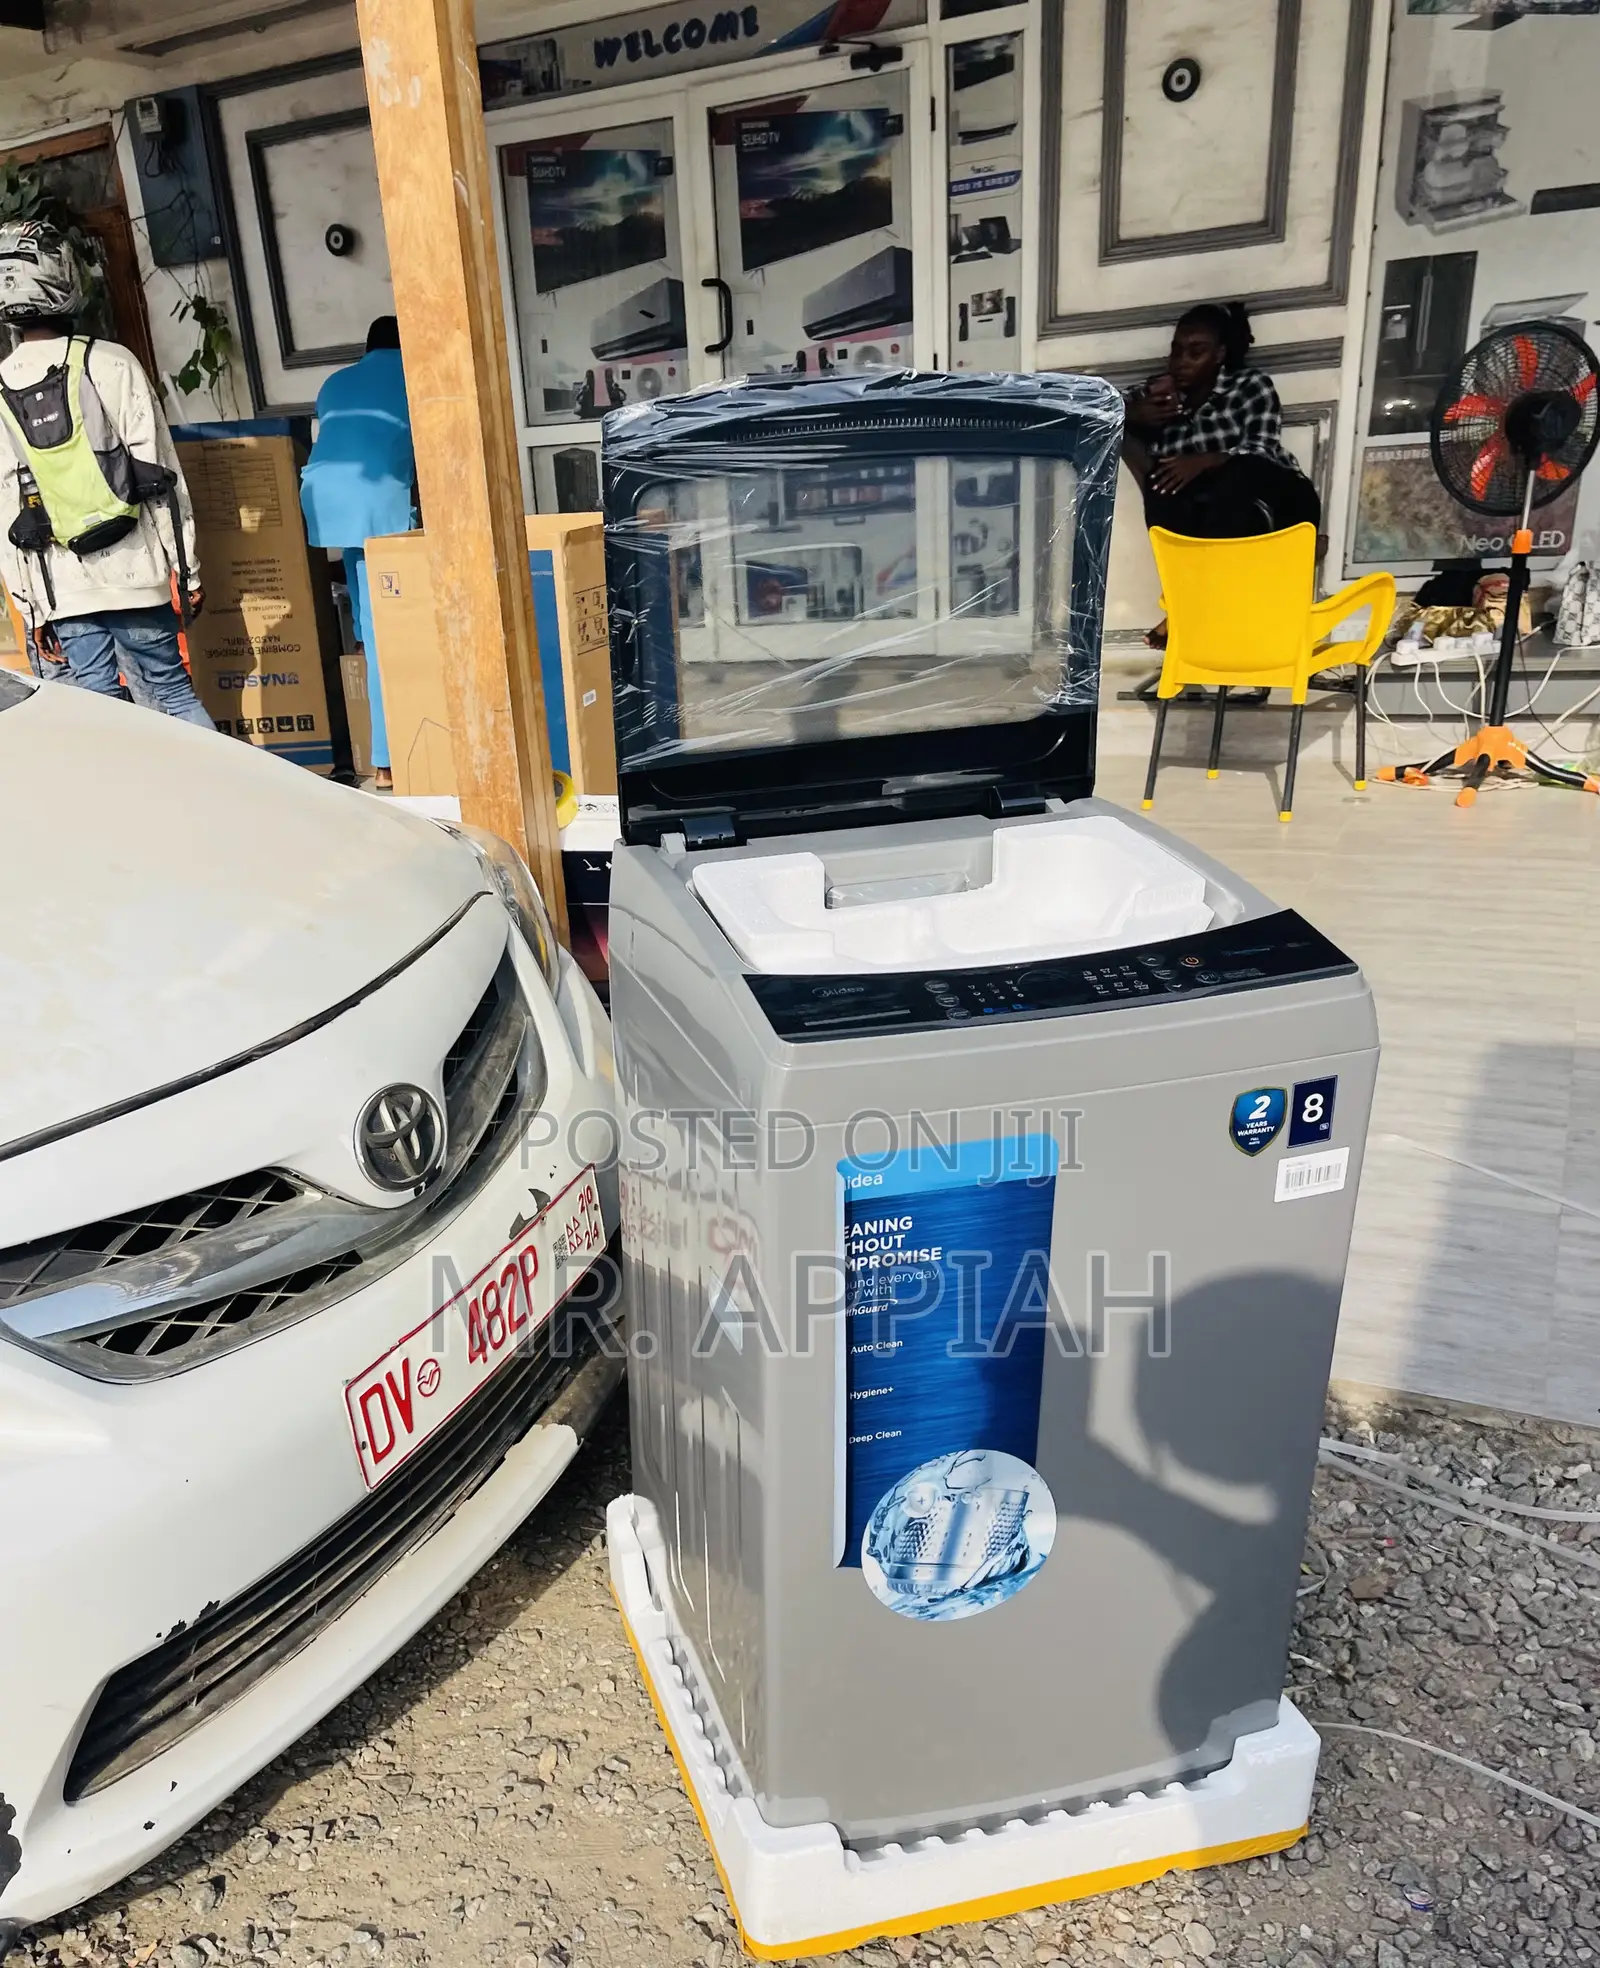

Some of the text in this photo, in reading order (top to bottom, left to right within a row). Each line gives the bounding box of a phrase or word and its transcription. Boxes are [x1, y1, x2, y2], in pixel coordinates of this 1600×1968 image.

[594, 5, 759, 68] WELCOME
[1460, 530, 1566, 552] Neo LED
[246, 643, 301, 657] COMBINED
[218, 672, 286, 690] NASCO
[1248, 1095, 1272, 1120] 2
[1302, 1093, 1324, 1123] 8
[1237, 1125, 1276, 1137] WARRANTY
[1246, 1120, 1268, 1129] YEARS
[845, 1172, 885, 1190] idea
[878, 1268, 940, 1285] everyday
[863, 1283, 893, 1297] with
[359, 1244, 539, 1466] DV 482P
[850, 1340, 904, 1355] Auto Clean
[849, 1386, 894, 1401] Hygiene+
[848, 1429, 902, 1444] Deep Clean
